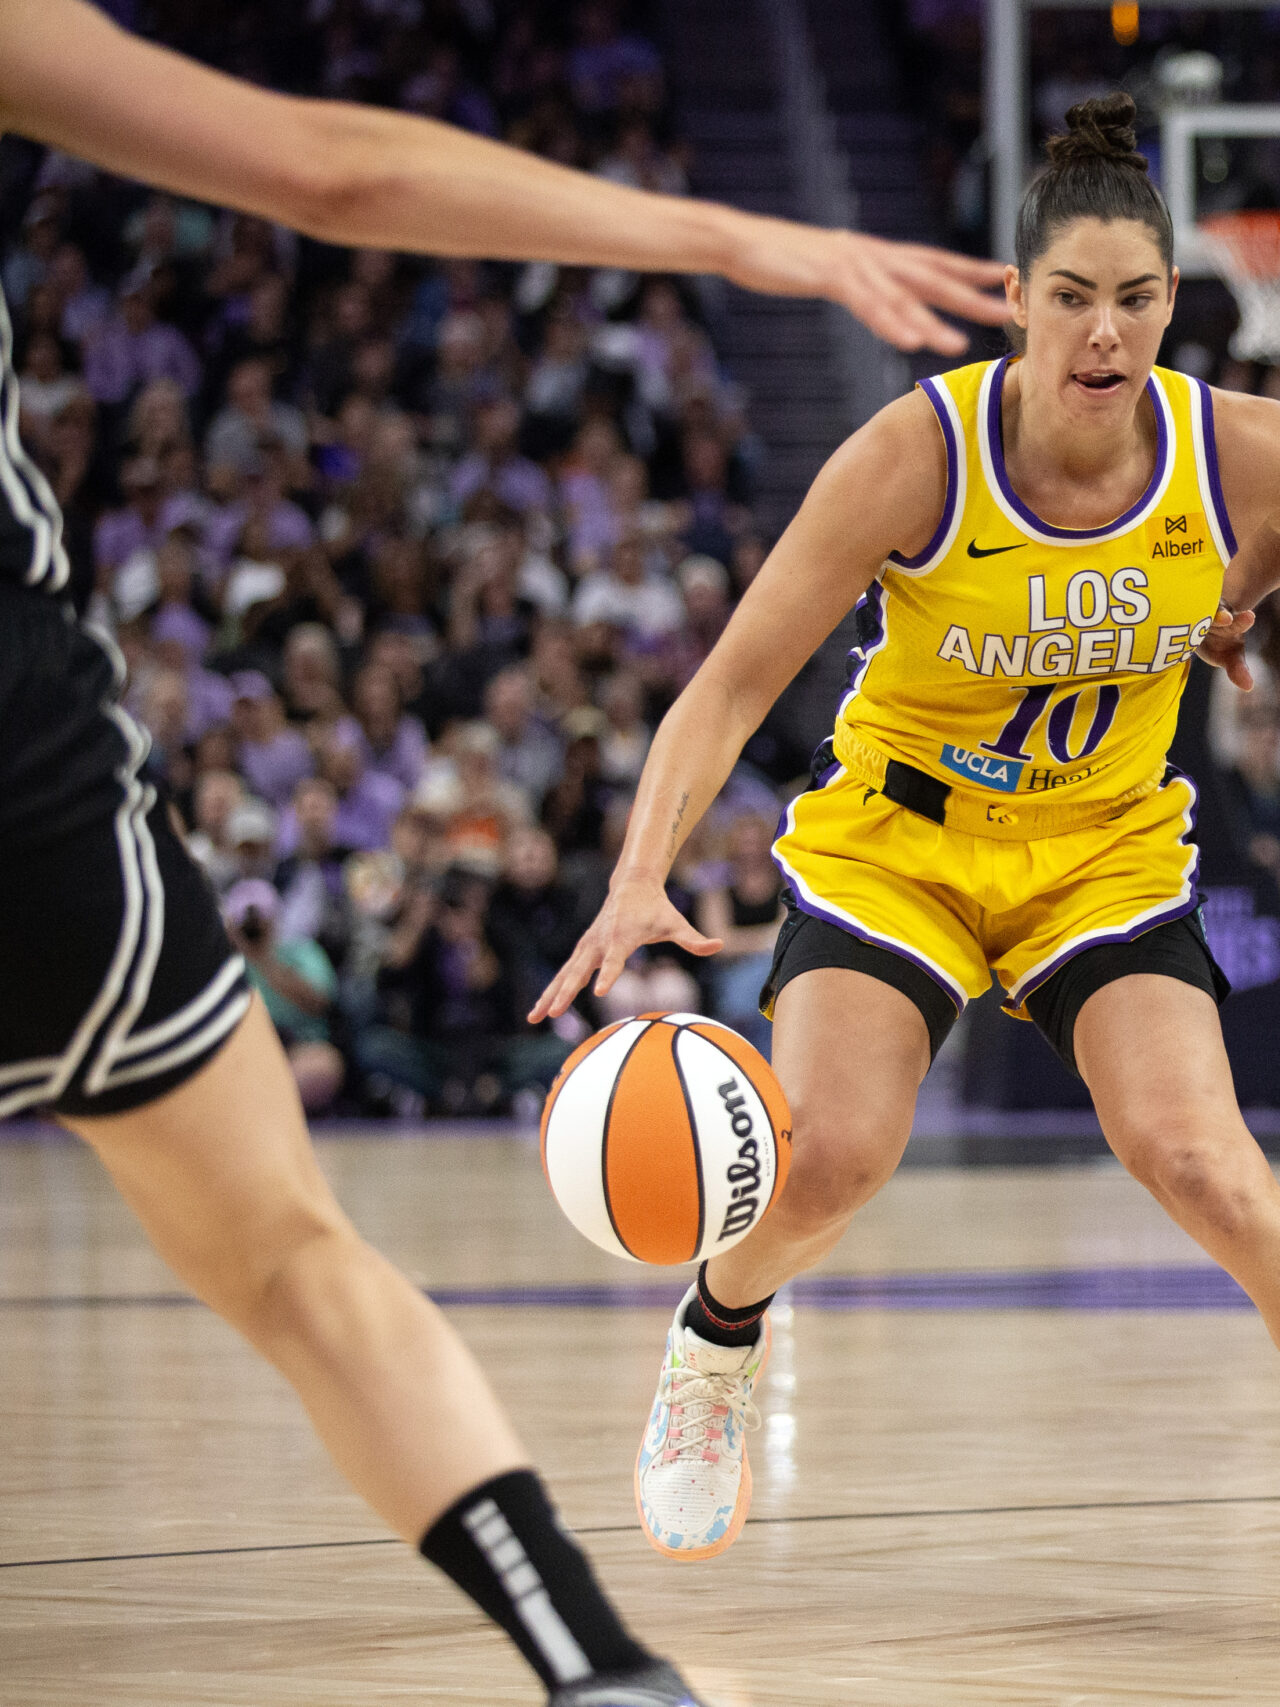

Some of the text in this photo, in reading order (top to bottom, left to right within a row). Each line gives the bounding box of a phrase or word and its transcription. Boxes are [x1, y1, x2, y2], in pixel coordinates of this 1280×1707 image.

[1152, 538, 1204, 559] Albert
[1028, 567, 1151, 633] LOS
[936, 616, 1213, 677] ANGELES
[979, 683, 1122, 764] 10
[952, 747, 1009, 783] UCLA
[716, 1076, 761, 1242] Wilson
